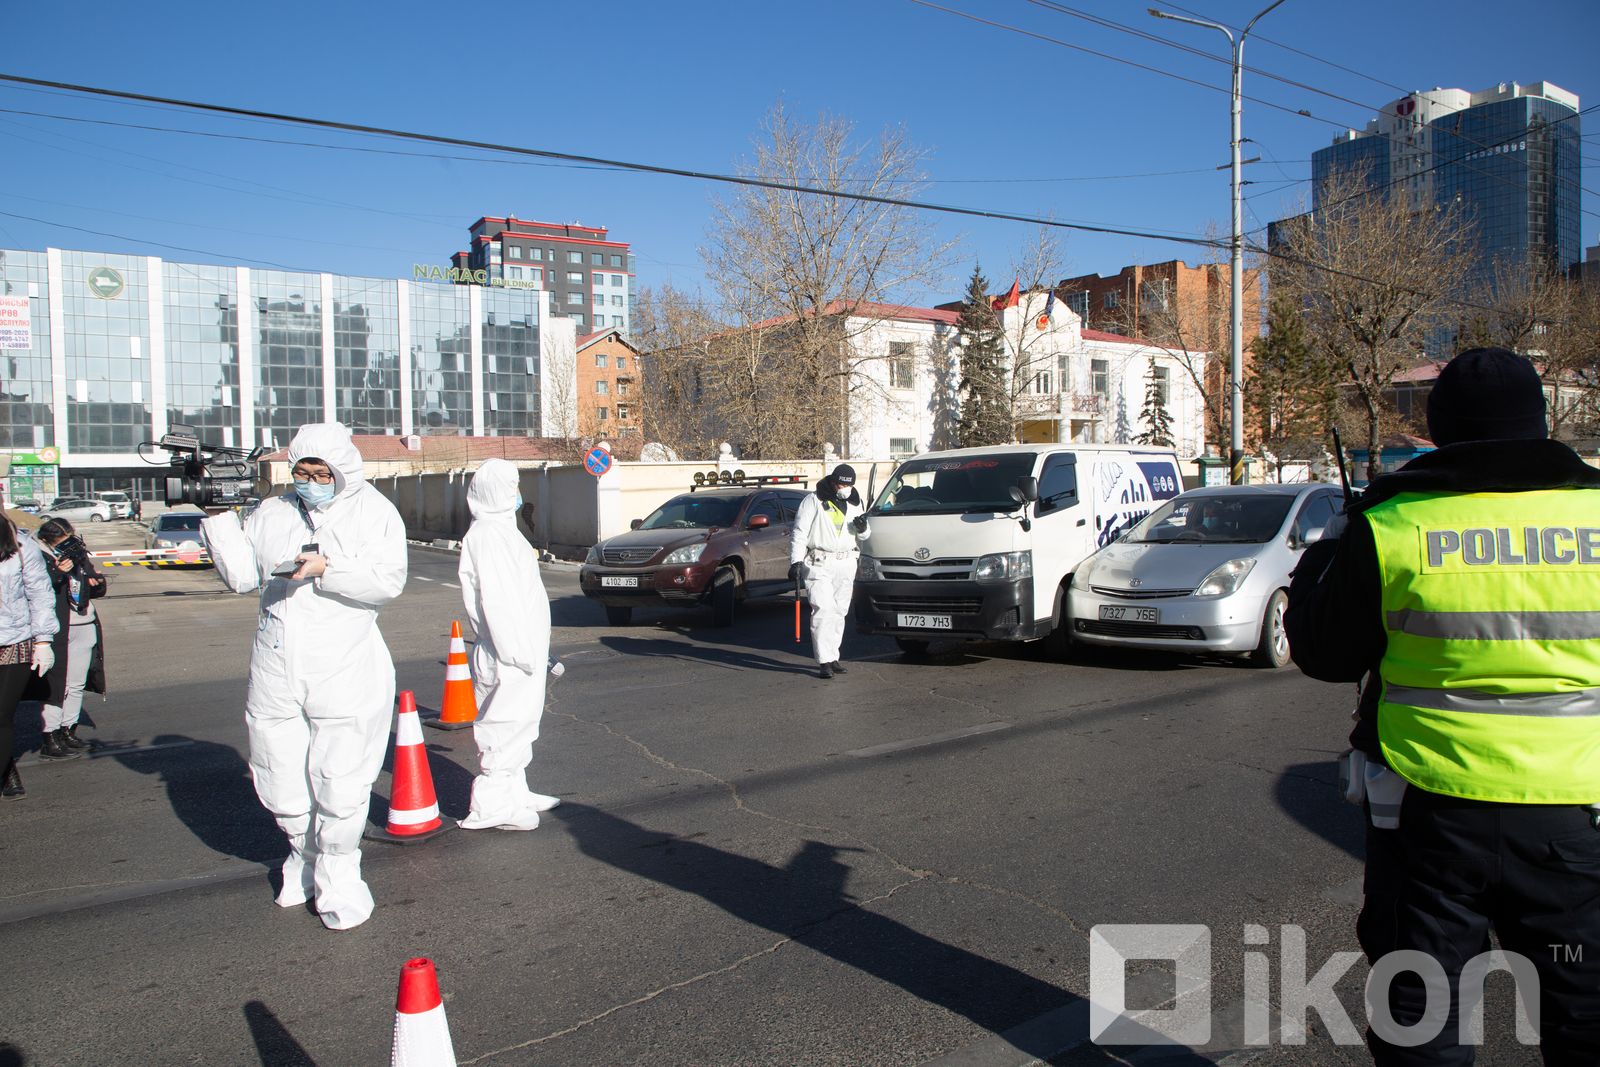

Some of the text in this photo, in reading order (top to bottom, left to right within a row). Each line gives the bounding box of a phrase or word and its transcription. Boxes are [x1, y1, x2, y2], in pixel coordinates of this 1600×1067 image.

[492, 278, 535, 289] BUILDING
[1427, 527, 1600, 567] POLICE
[606, 577, 621, 586] 4102
[1103, 607, 1155, 621] 7327 УБЕ
[904, 615, 926, 627] 1773
